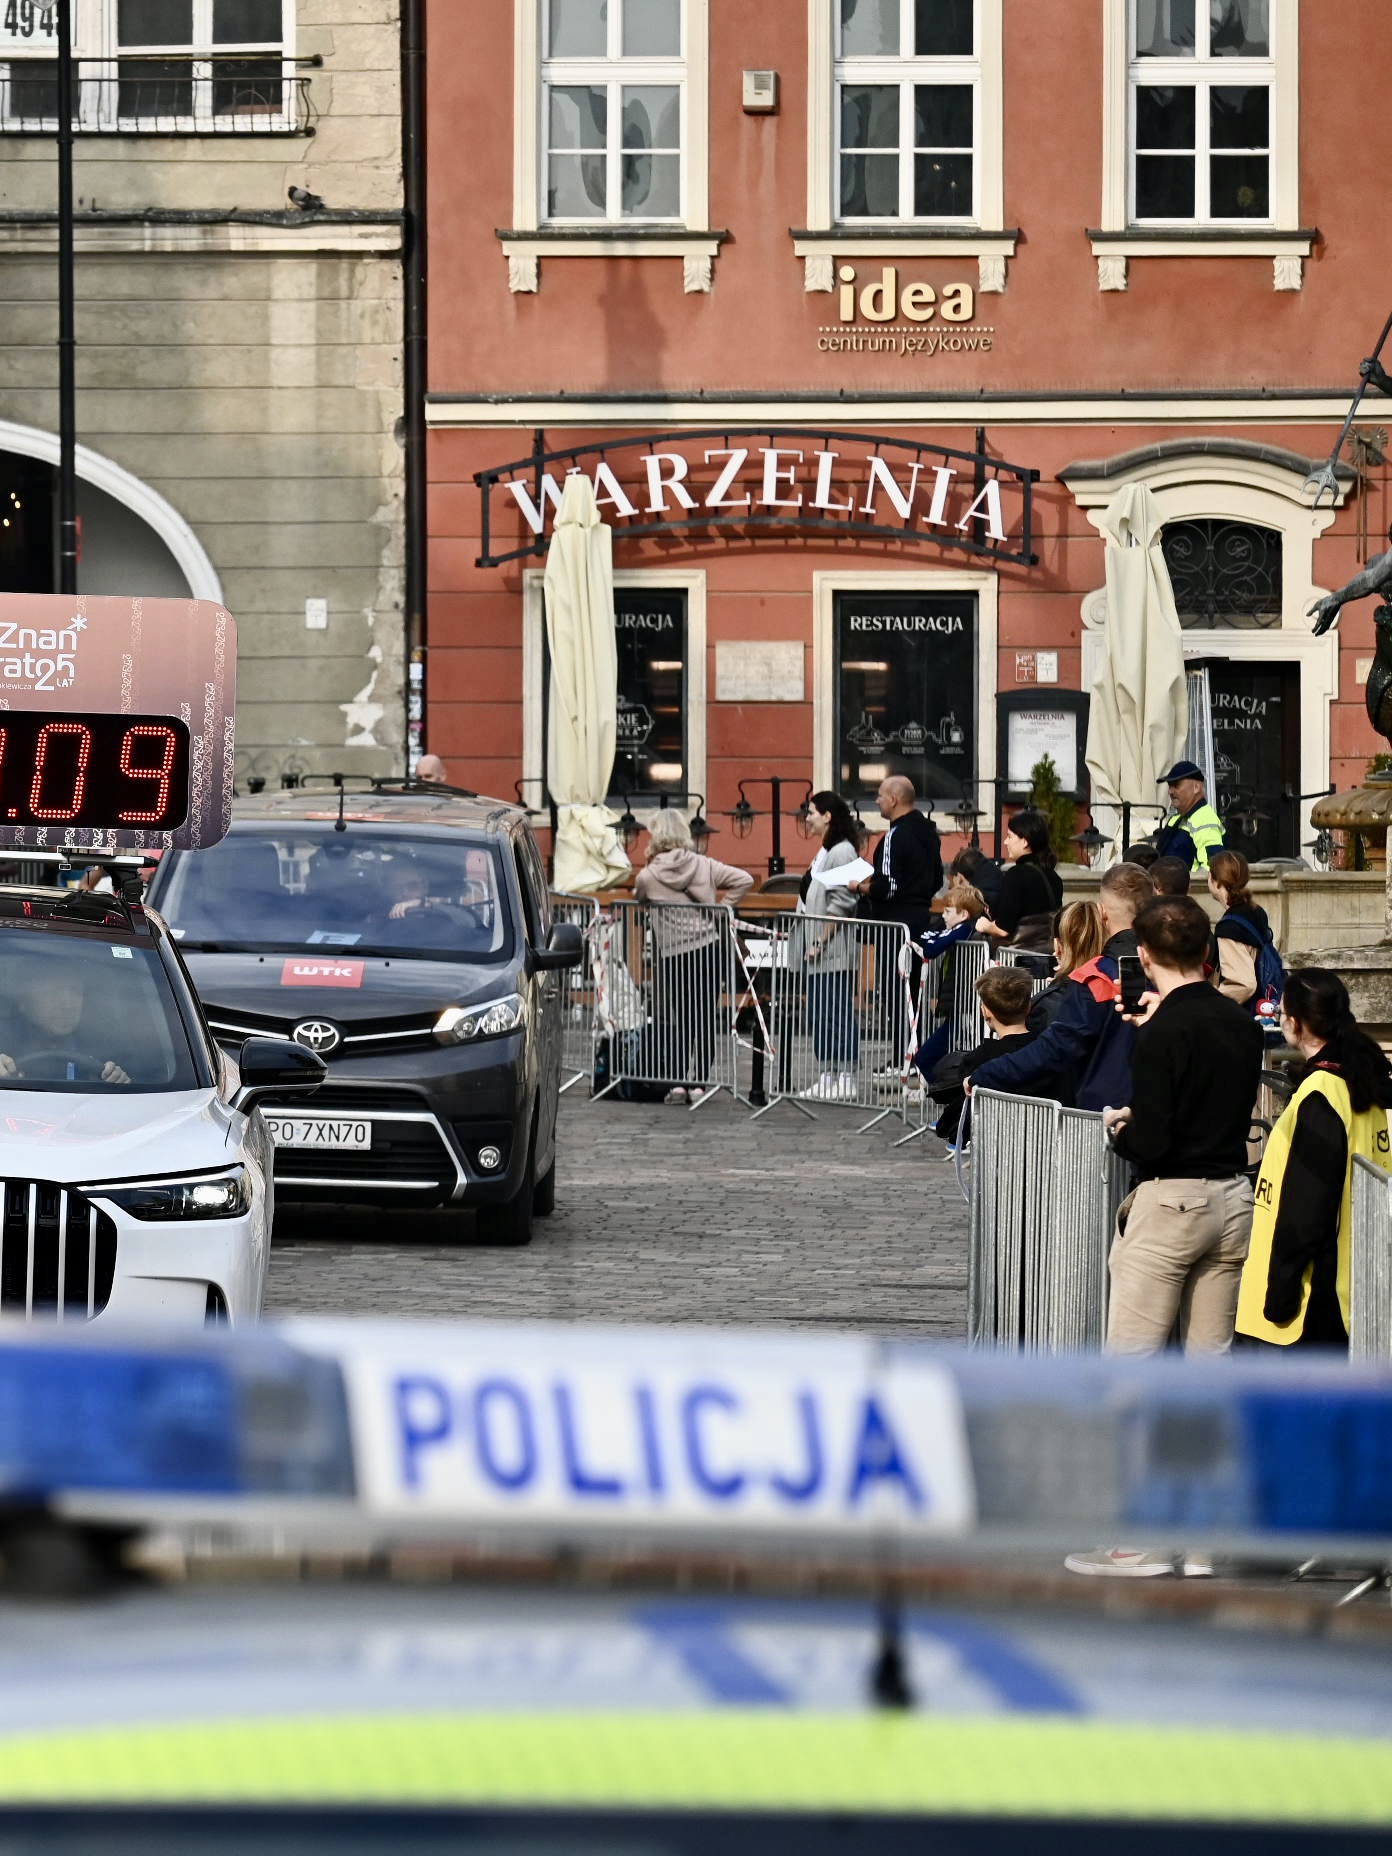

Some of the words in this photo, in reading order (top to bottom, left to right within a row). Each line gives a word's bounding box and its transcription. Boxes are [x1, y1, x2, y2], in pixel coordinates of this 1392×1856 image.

[4, 0, 34, 37] 49
[40, 2, 58, 37] 4
[839, 265, 973, 322] idea
[818, 335, 896, 351] centrum
[900, 334, 992, 357] językowe
[505, 448, 1007, 541] WARZELNIA
[614, 614, 674, 630] URACJA
[850, 616, 963, 634] RESTAURACJA
[56, 678, 75, 687] LAT
[1211, 693, 1266, 715] URACJA
[1213, 718, 1263, 730] ELNIA
[268, 1121, 294, 1141] PO
[302, 1122, 366, 1143] 7XN70
[392, 1375, 931, 1510] POLICJA
